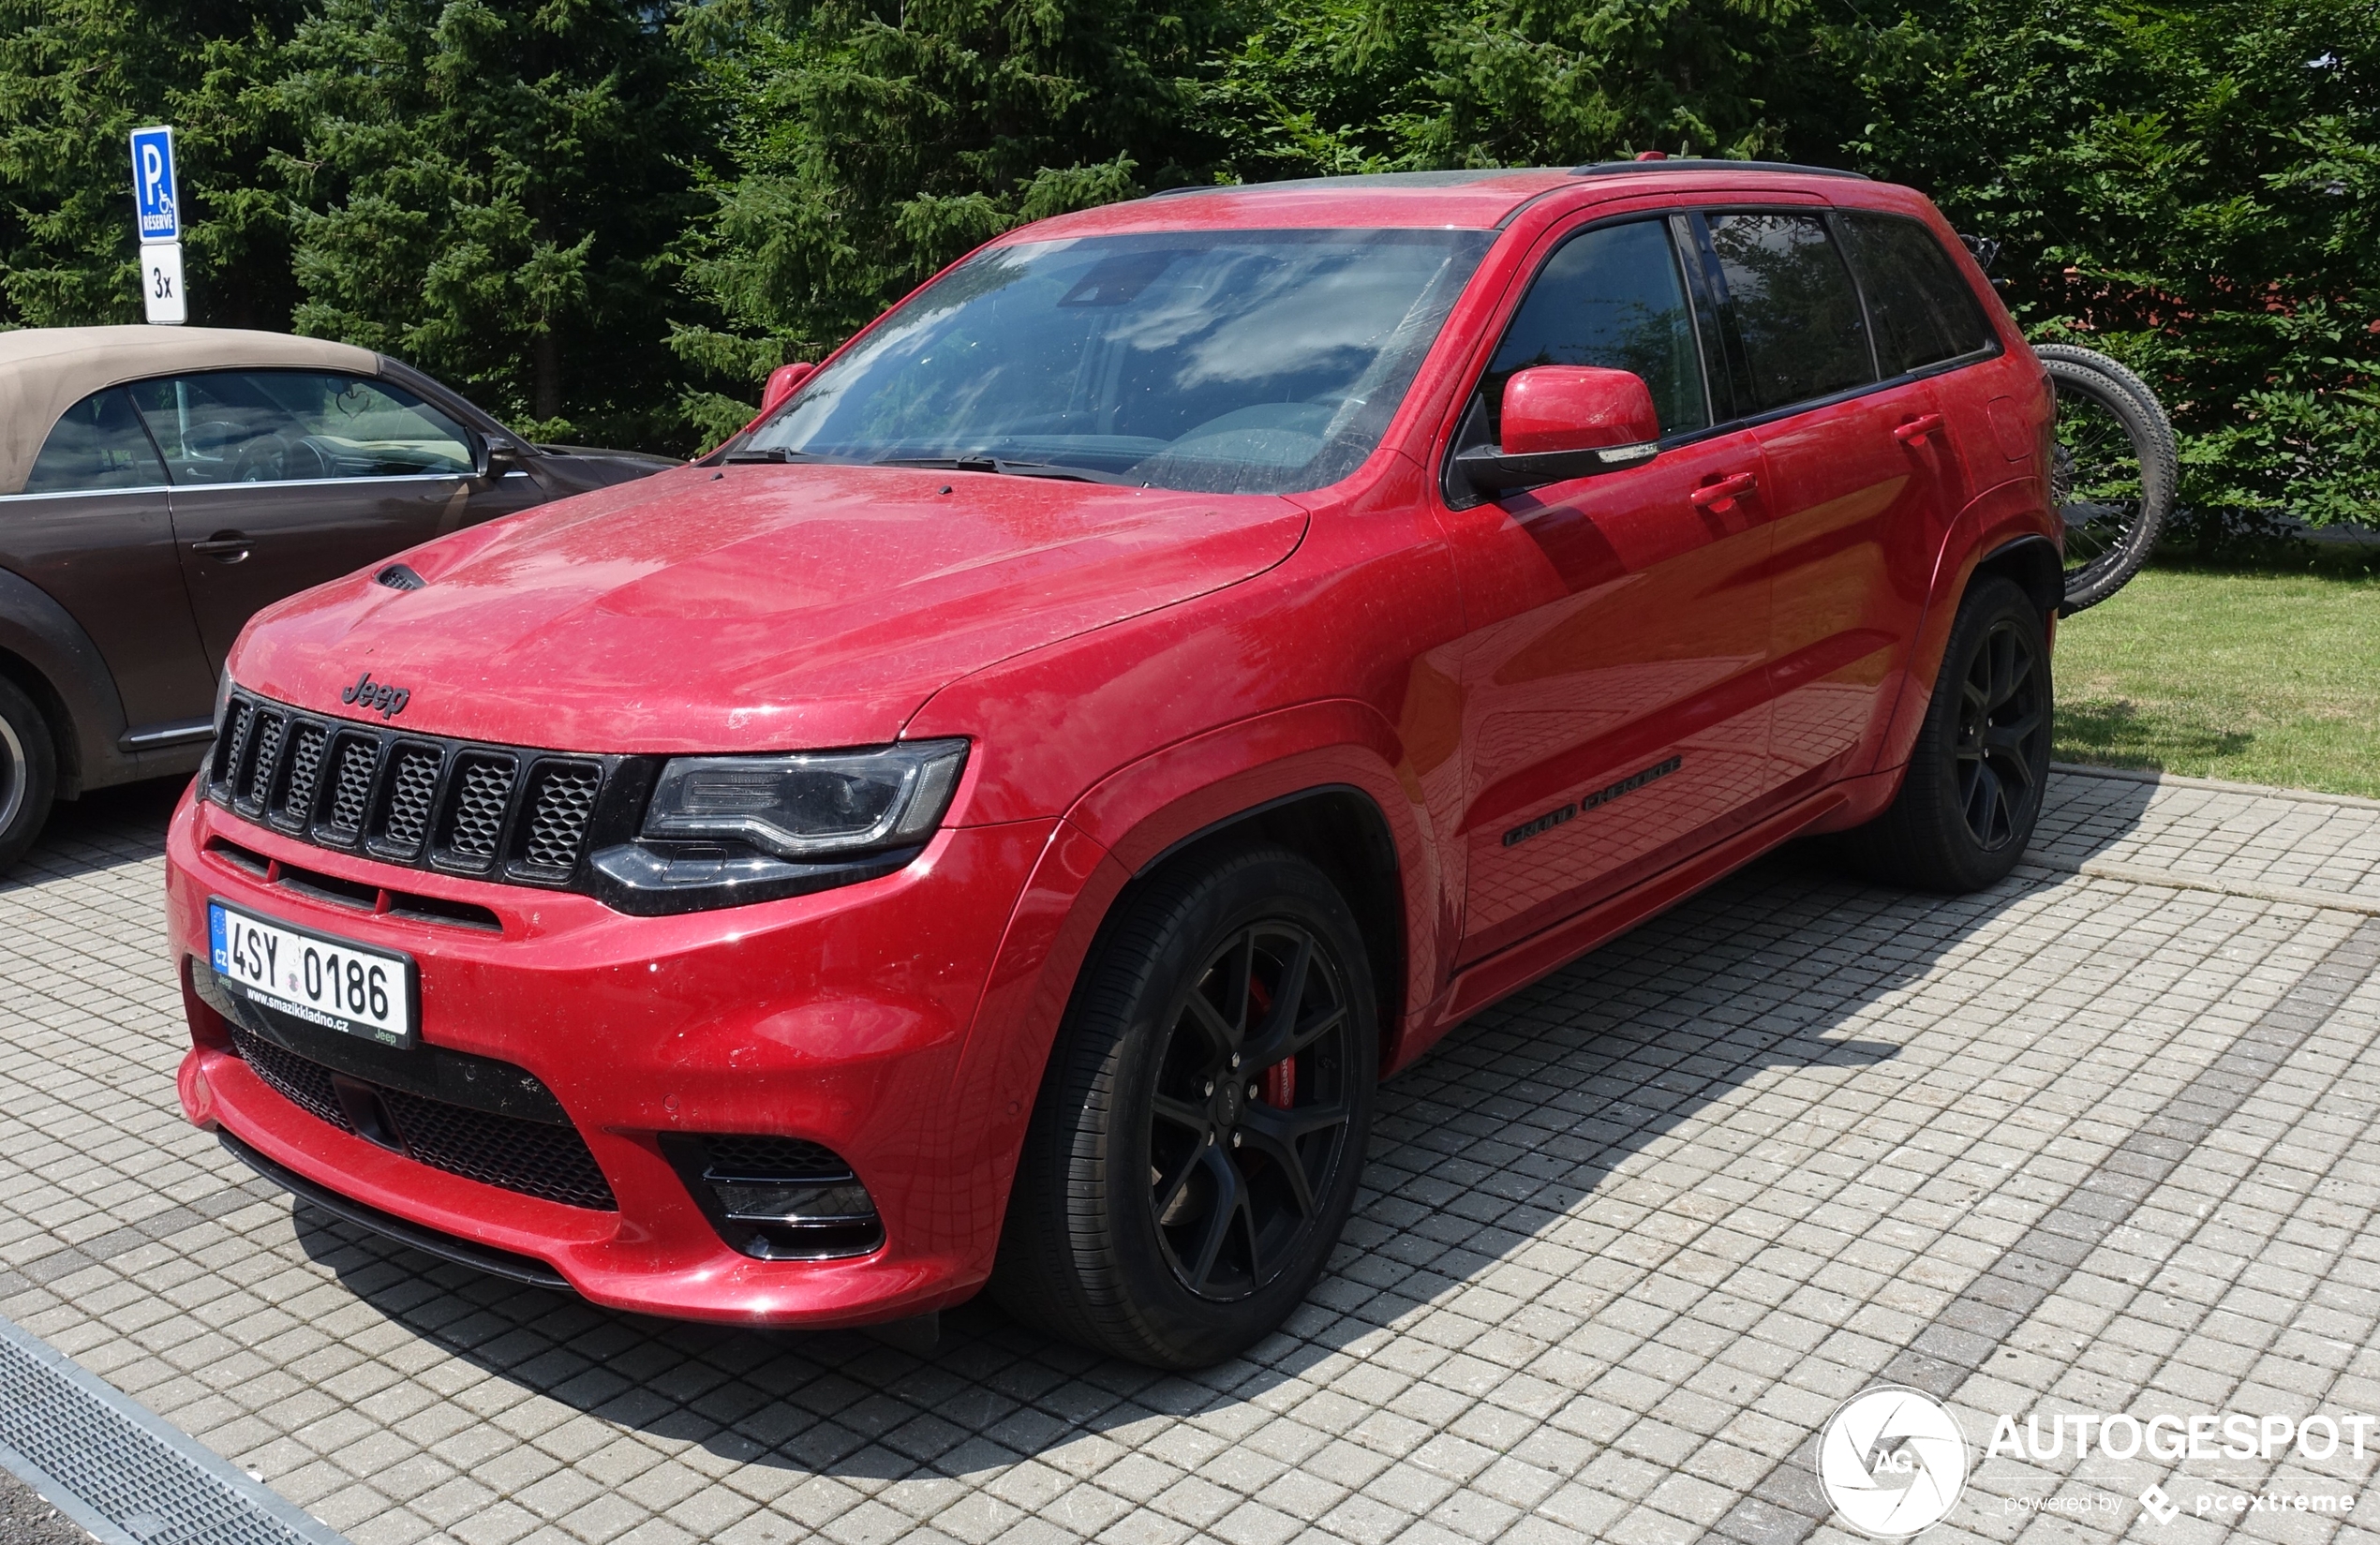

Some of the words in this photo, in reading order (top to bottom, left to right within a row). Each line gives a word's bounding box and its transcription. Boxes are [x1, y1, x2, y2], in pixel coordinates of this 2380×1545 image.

[141, 143, 162, 205] P
[142, 211, 173, 231] RÉSERVÉ
[153, 267, 172, 298] 3x
[341, 672, 410, 720] Jeep
[215, 948, 228, 967] CZ
[232, 922, 277, 988] 4SY
[304, 946, 388, 1020] 0186
[246, 987, 350, 1032] www.smazikkladno.cz
[375, 1029, 397, 1045] Jeep
